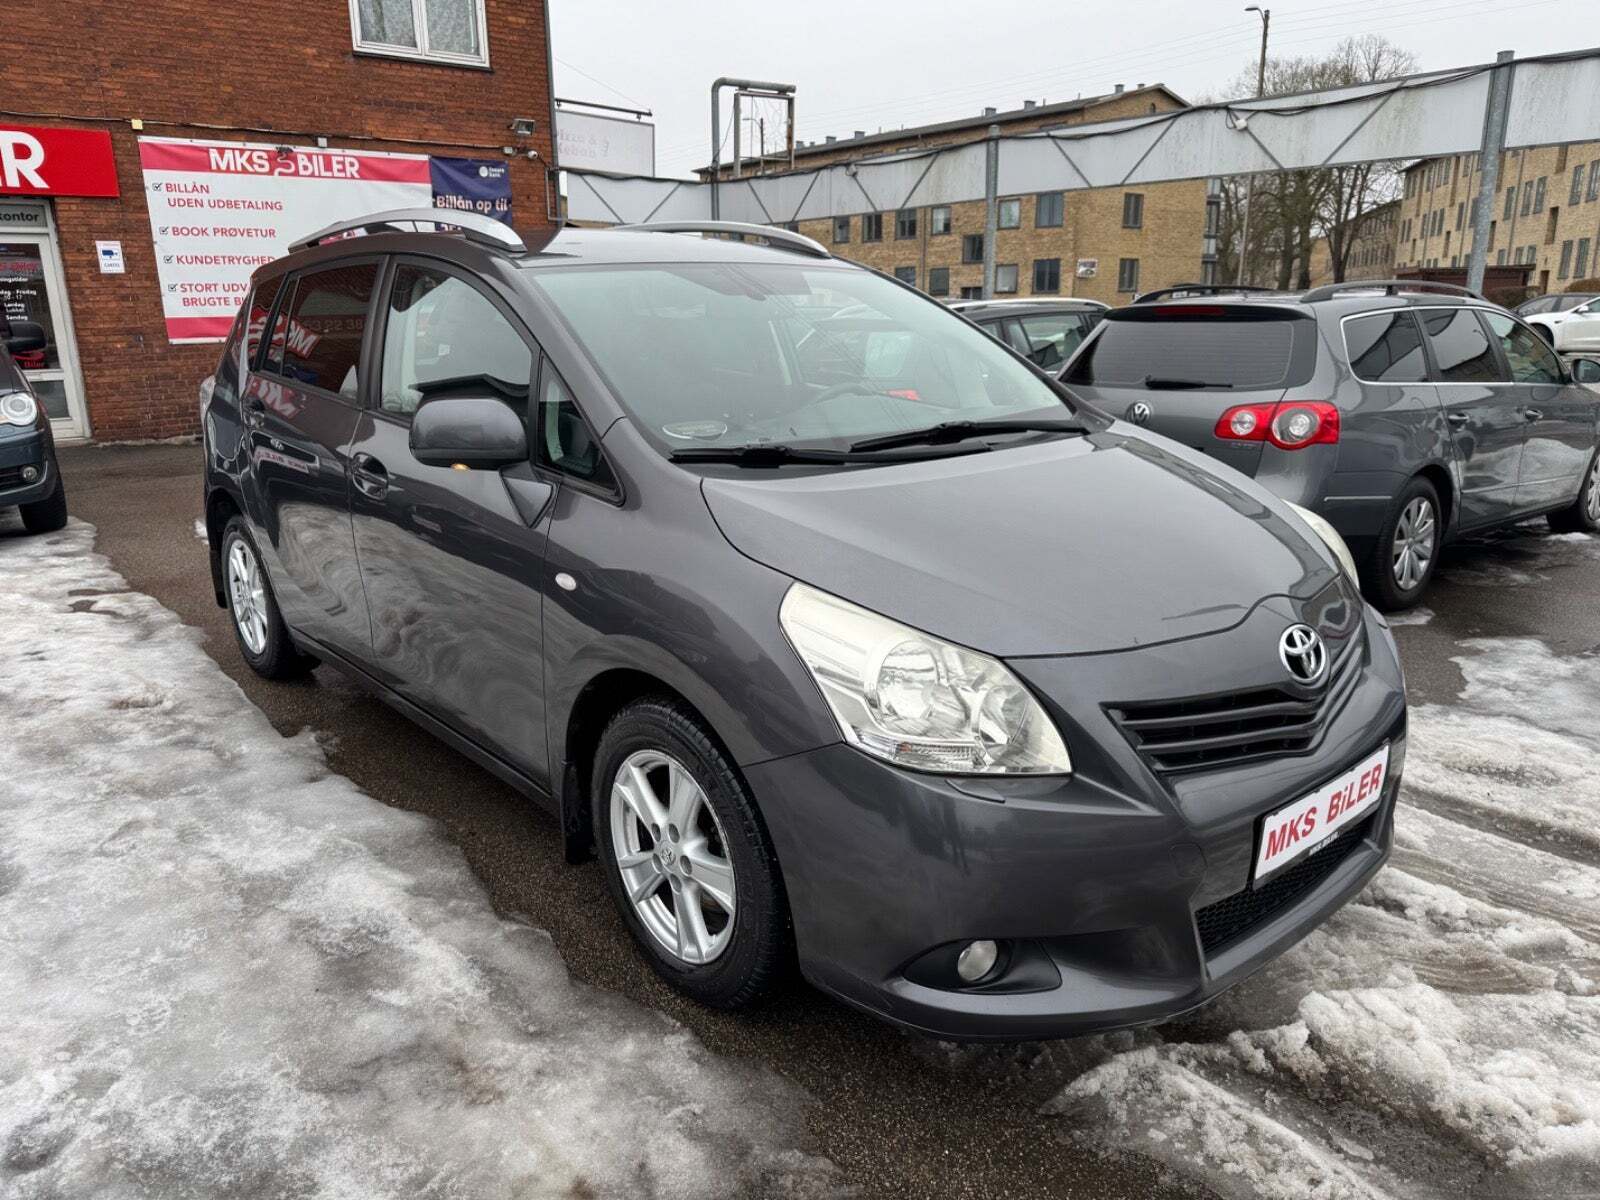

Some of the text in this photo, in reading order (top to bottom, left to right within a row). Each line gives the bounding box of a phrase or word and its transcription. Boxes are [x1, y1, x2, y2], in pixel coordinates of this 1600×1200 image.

[0, 130, 50, 188] R
[209, 149, 360, 178] MKS BILER
[165, 182, 210, 194] BILLÅN
[168, 198, 283, 211] UDEN UDBETALING
[436, 195, 509, 214] Billån op til
[172, 226, 276, 238] BOOK PRØVETUR
[180, 283, 218, 293] STORT
[183, 297, 230, 307] BRUGTE
[1264, 806, 1317, 861] MKS
